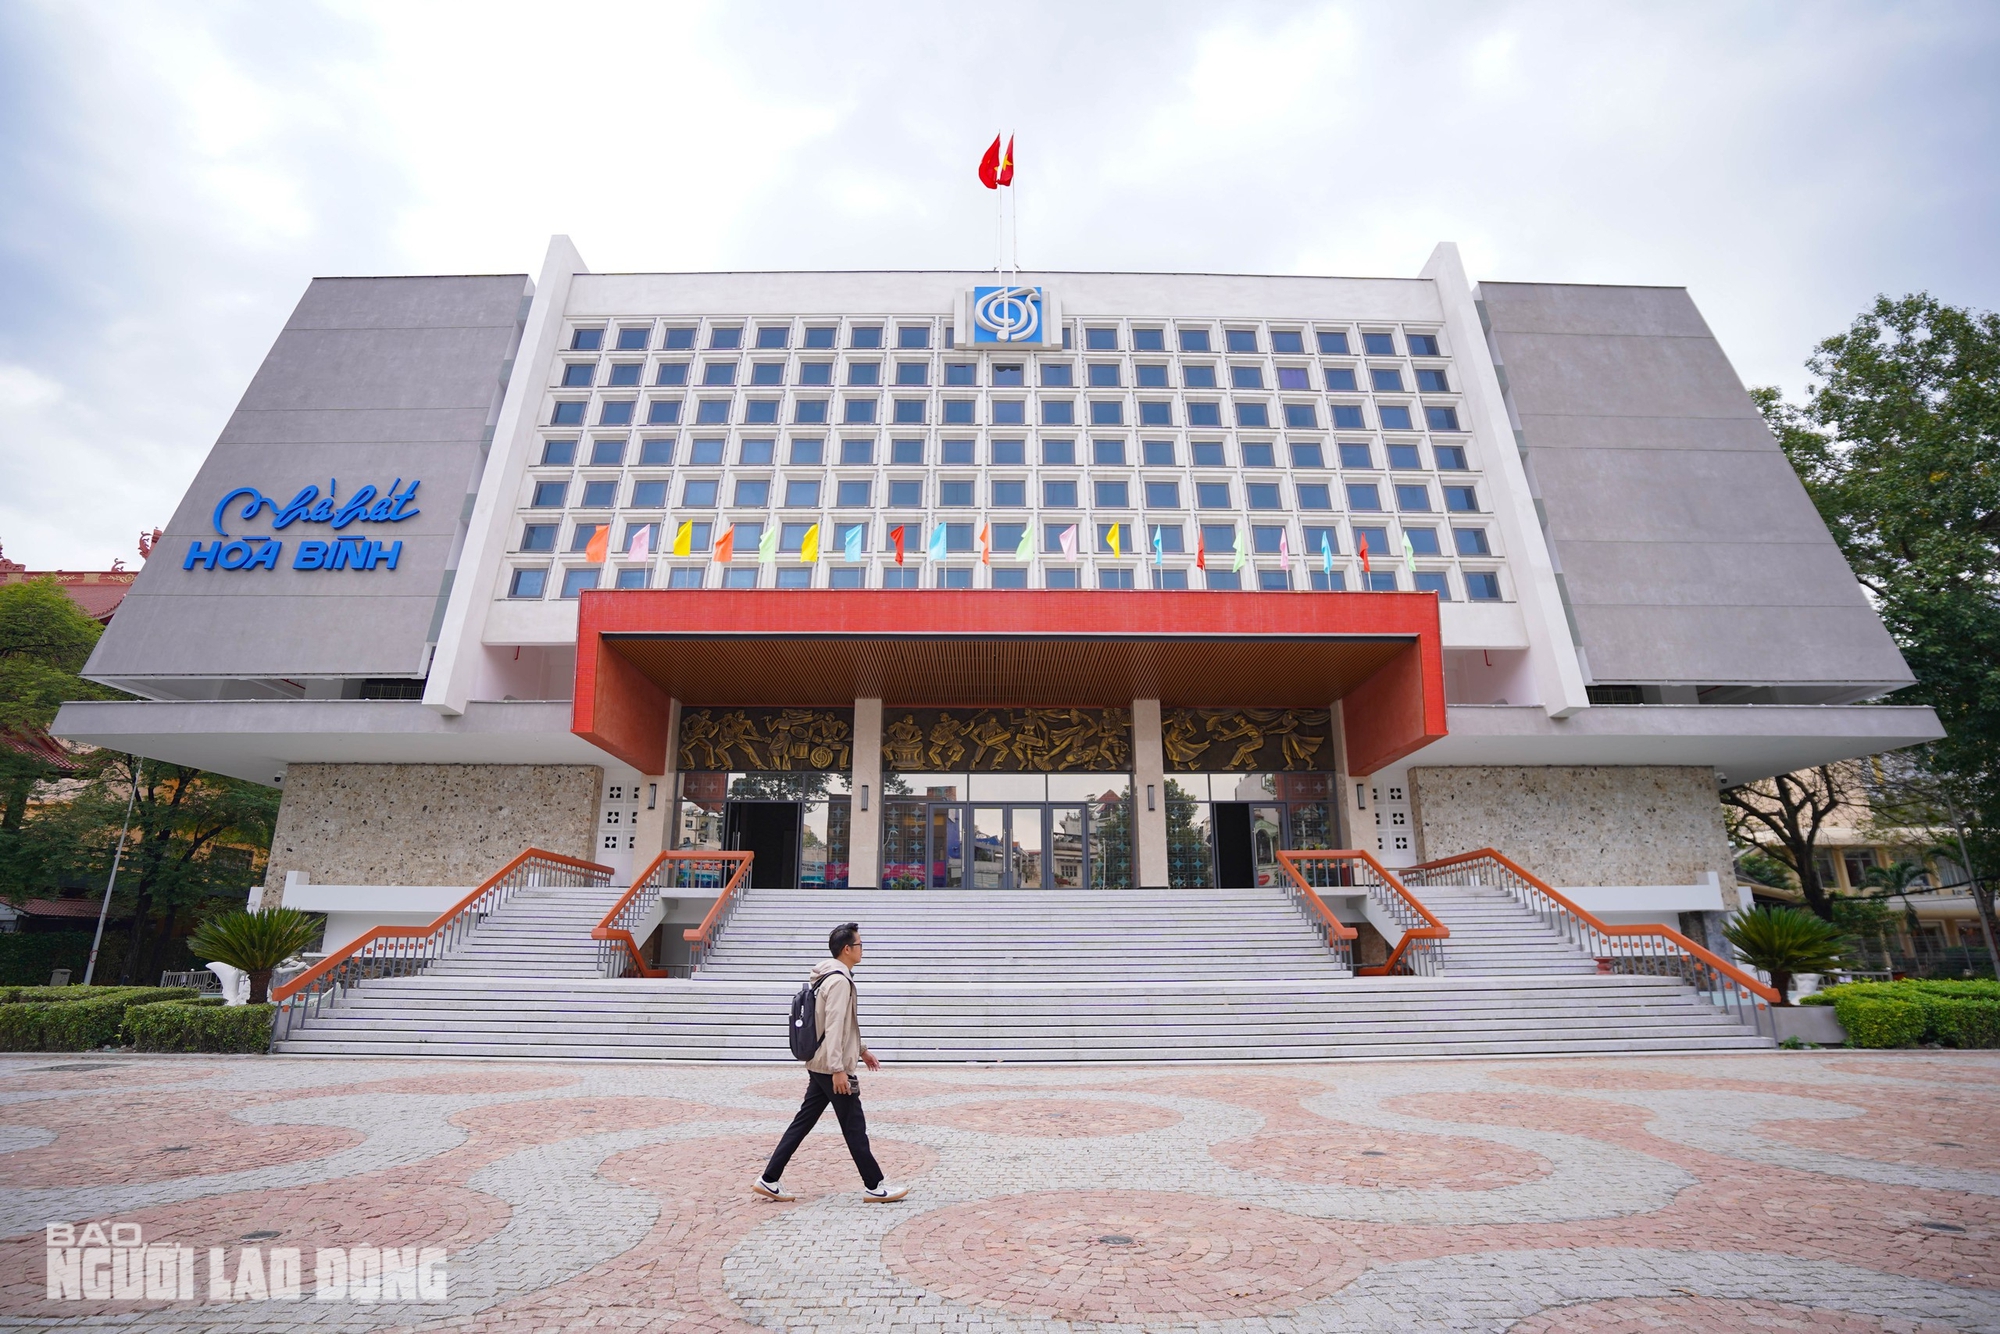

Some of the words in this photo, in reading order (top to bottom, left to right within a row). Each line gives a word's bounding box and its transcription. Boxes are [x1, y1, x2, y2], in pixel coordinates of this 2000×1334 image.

[213, 477, 336, 536] Nhà
[330, 477, 421, 531] hát
[293, 535, 403, 570] BÌNH
